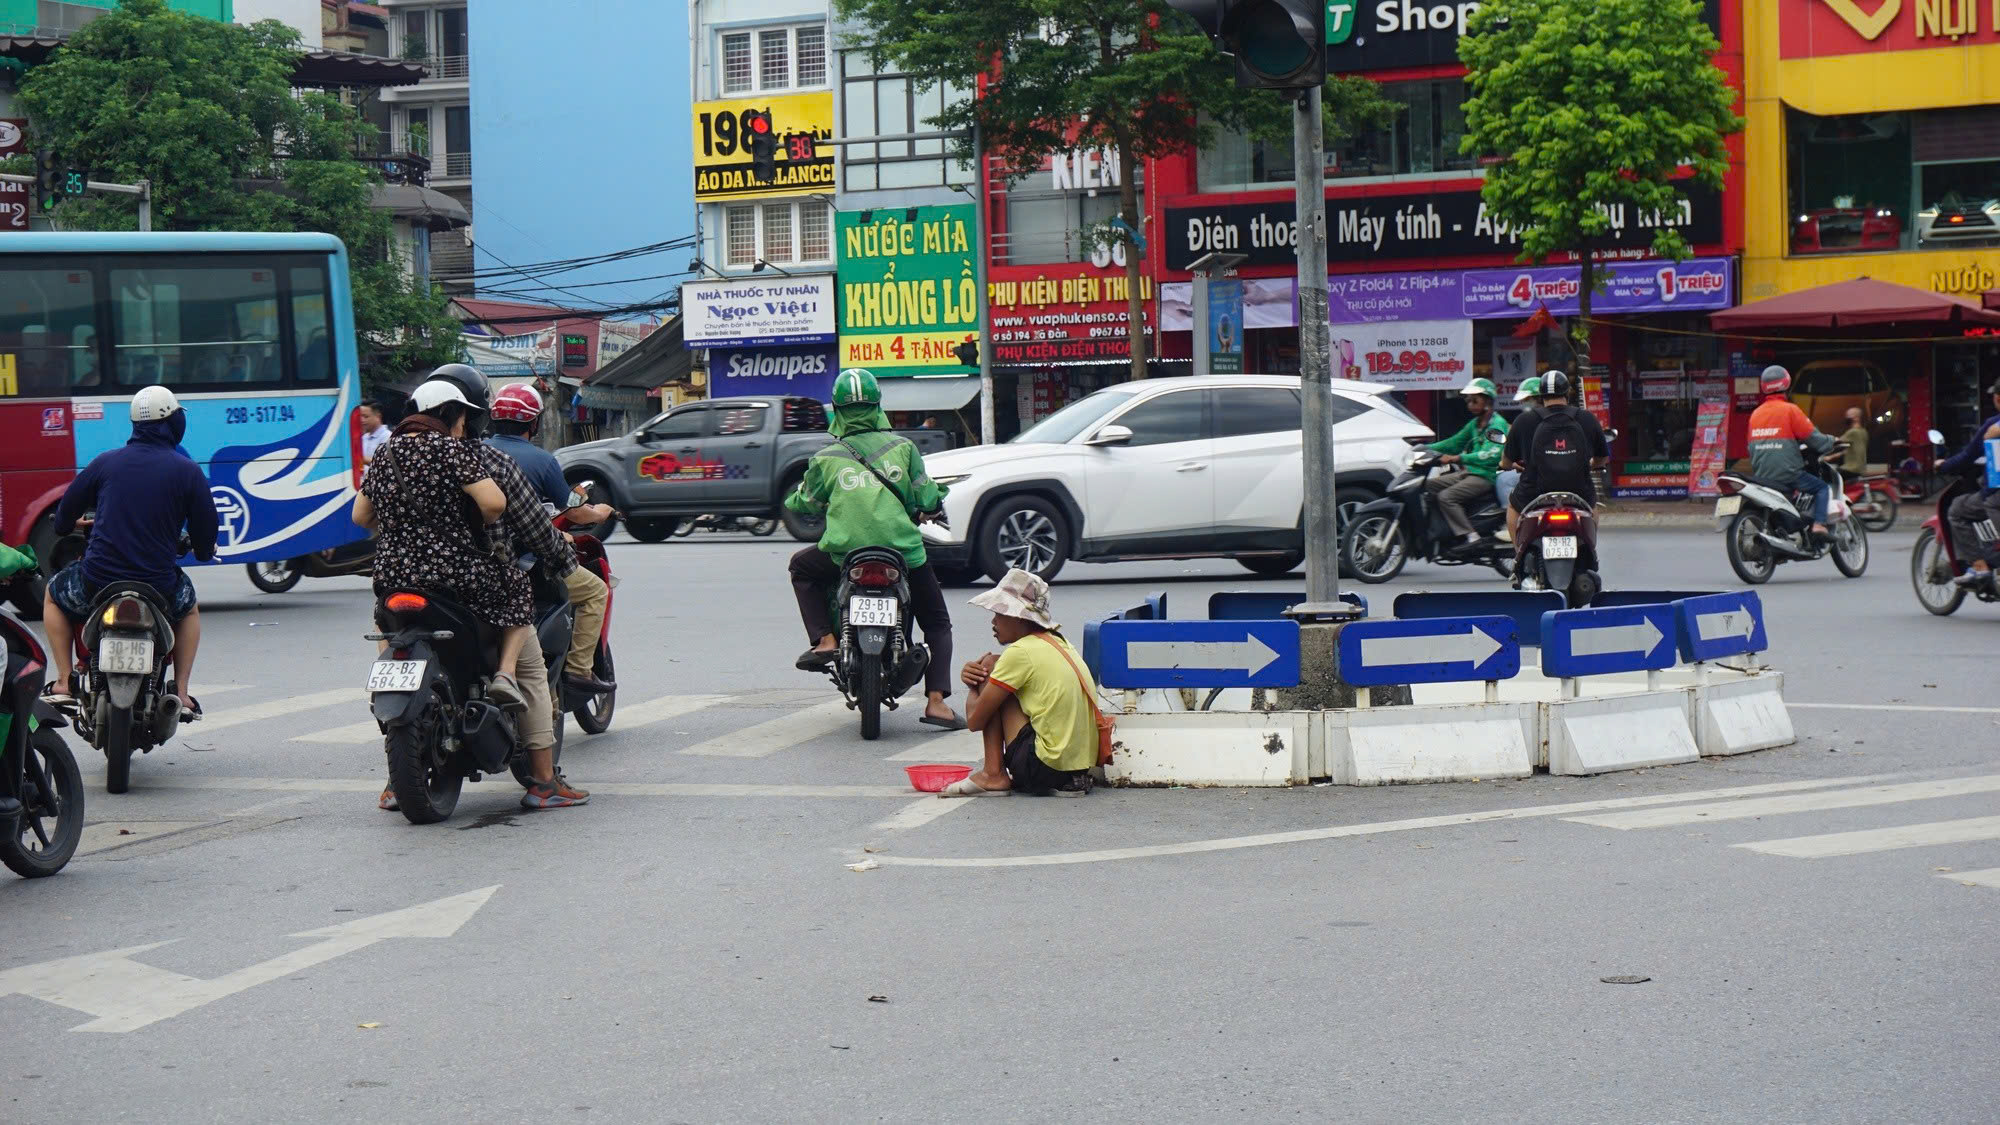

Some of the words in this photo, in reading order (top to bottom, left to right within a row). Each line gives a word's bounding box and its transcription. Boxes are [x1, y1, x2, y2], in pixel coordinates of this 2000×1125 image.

[790, 136, 812, 160] 30
[698, 170, 721, 190] ÁO
[722, 169, 745, 189] DA
[846, 216, 915, 259] NƯỚC
[922, 212, 969, 254] MÍA
[1338, 206, 1386, 252] Máy
[1396, 203, 1441, 241] tính
[1349, 280, 1357, 291] Z
[1360, 278, 1393, 291] Fold4
[1399, 277, 1408, 290] Z
[1410, 275, 1439, 293] Flip4
[1659, 269, 1675, 299] 1
[1677, 272, 1723, 293] TRIỆU
[1929, 261, 1994, 293] NƯỚC
[697, 288, 722, 301] NHÀ
[723, 285, 764, 299] THUỐC
[766, 286, 783, 297] TƯ
[786, 284, 819, 295] NHÂN
[845, 260, 937, 328] KHỔNG
[942, 258, 977, 324] LỒ
[987, 281, 1018, 312] PHỤ
[1021, 274, 1059, 310] KIỆN
[1062, 272, 1101, 308] ĐIỆN
[1509, 275, 1533, 305] 4
[1534, 277, 1579, 300] TRIỆU
[707, 304, 760, 321] Ngọc
[763, 300, 810, 318] Việt
[1014, 330, 1030, 340] 194
[1047, 327, 1068, 339] Đàn
[1089, 327, 1113, 338] 0967
[1377, 339, 1407, 348] iPhone
[1409, 338, 1418, 347] 13
[1420, 337, 1449, 347] 128GB
[850, 343, 884, 361] MUA
[889, 335, 905, 360] 4
[910, 337, 955, 363] TẶNG
[727, 353, 826, 380] Salonpas
[1365, 350, 1431, 376] 18.99
[839, 460, 903, 491] Grab
[858, 599, 889, 611] 29-B1
[853, 612, 892, 624] 759.21
[109, 641, 145, 656] 30-H6
[109, 656, 145, 671] 1523
[378, 662, 417, 675] 22-B2
[370, 676, 416, 688] 584.24
